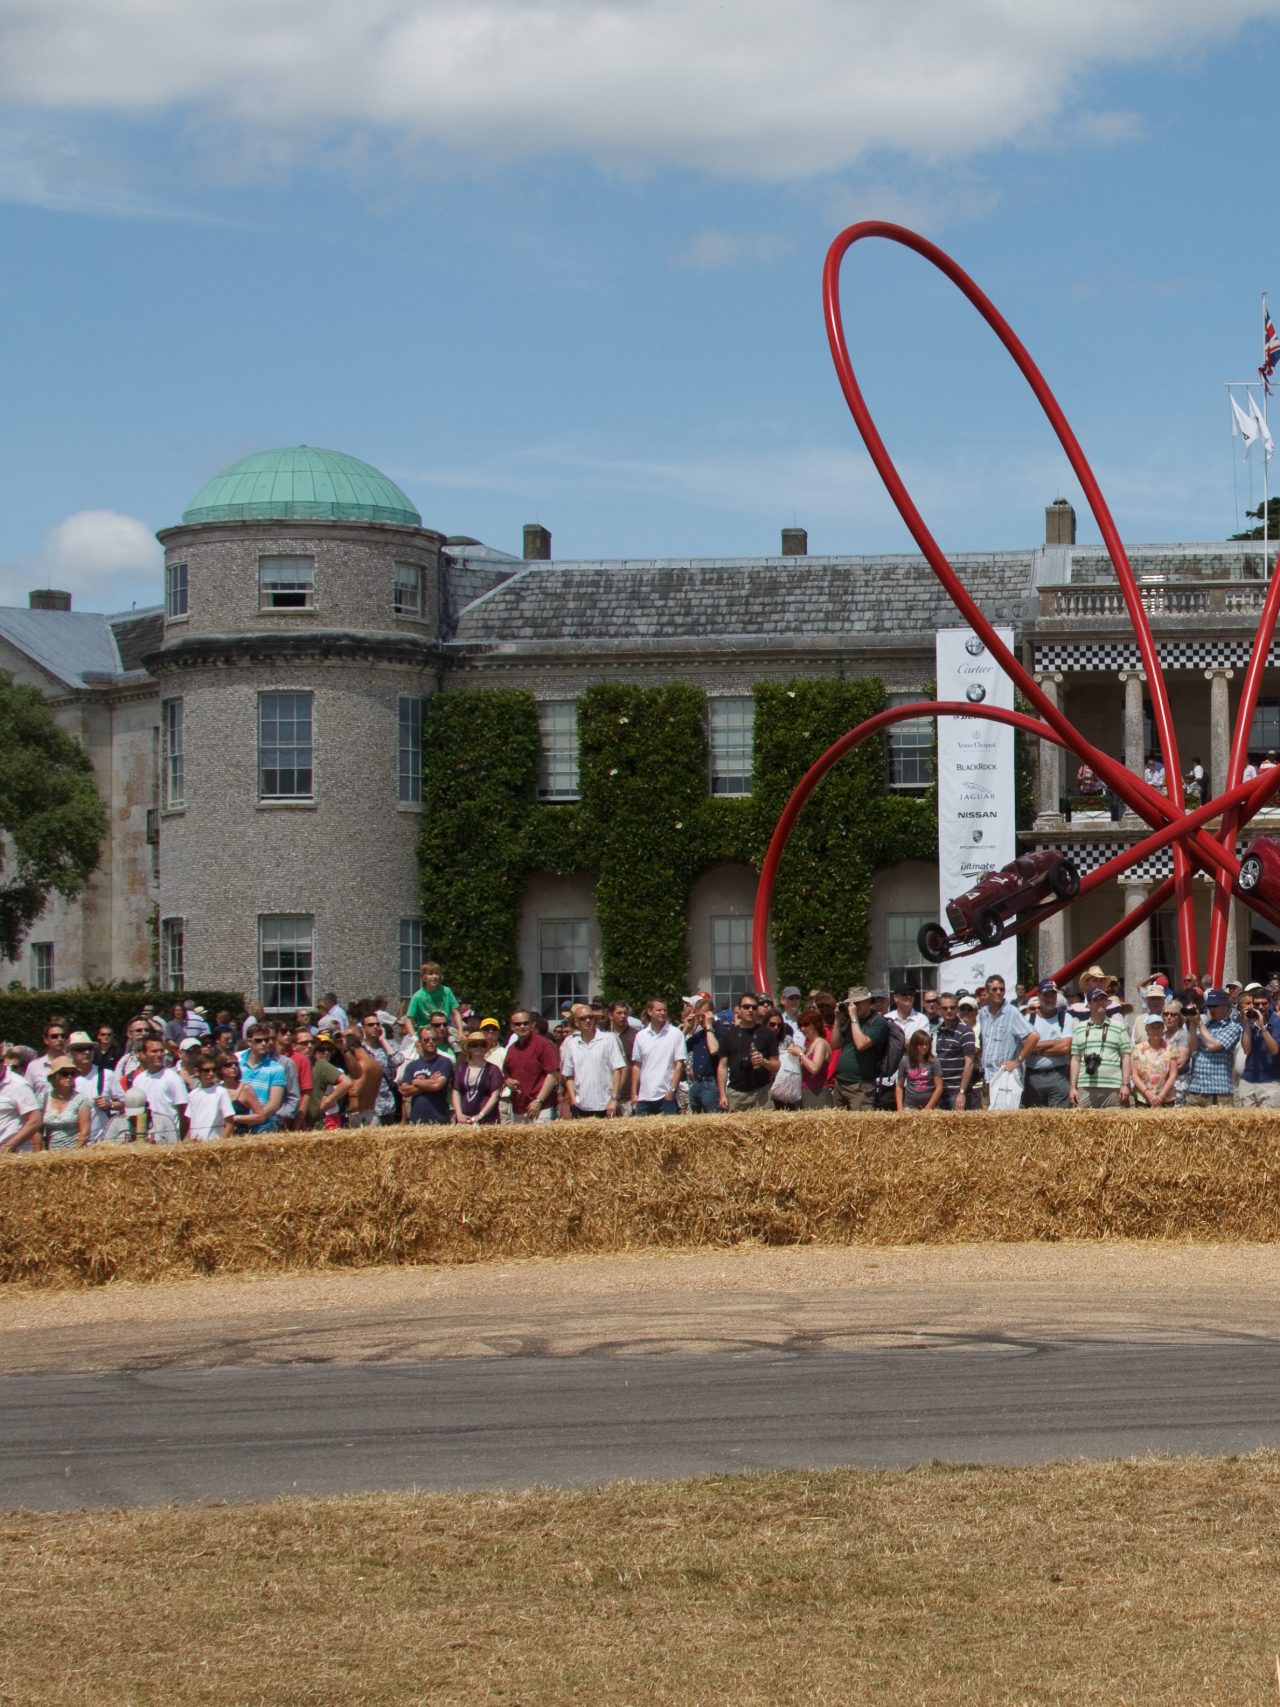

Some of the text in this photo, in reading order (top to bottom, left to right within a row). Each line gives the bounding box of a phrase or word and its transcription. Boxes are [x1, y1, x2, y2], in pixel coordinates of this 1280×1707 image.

[957, 662, 994, 675] Cartier
[960, 793, 995, 801] JAGUAR
[957, 811, 997, 819] NISSAN
